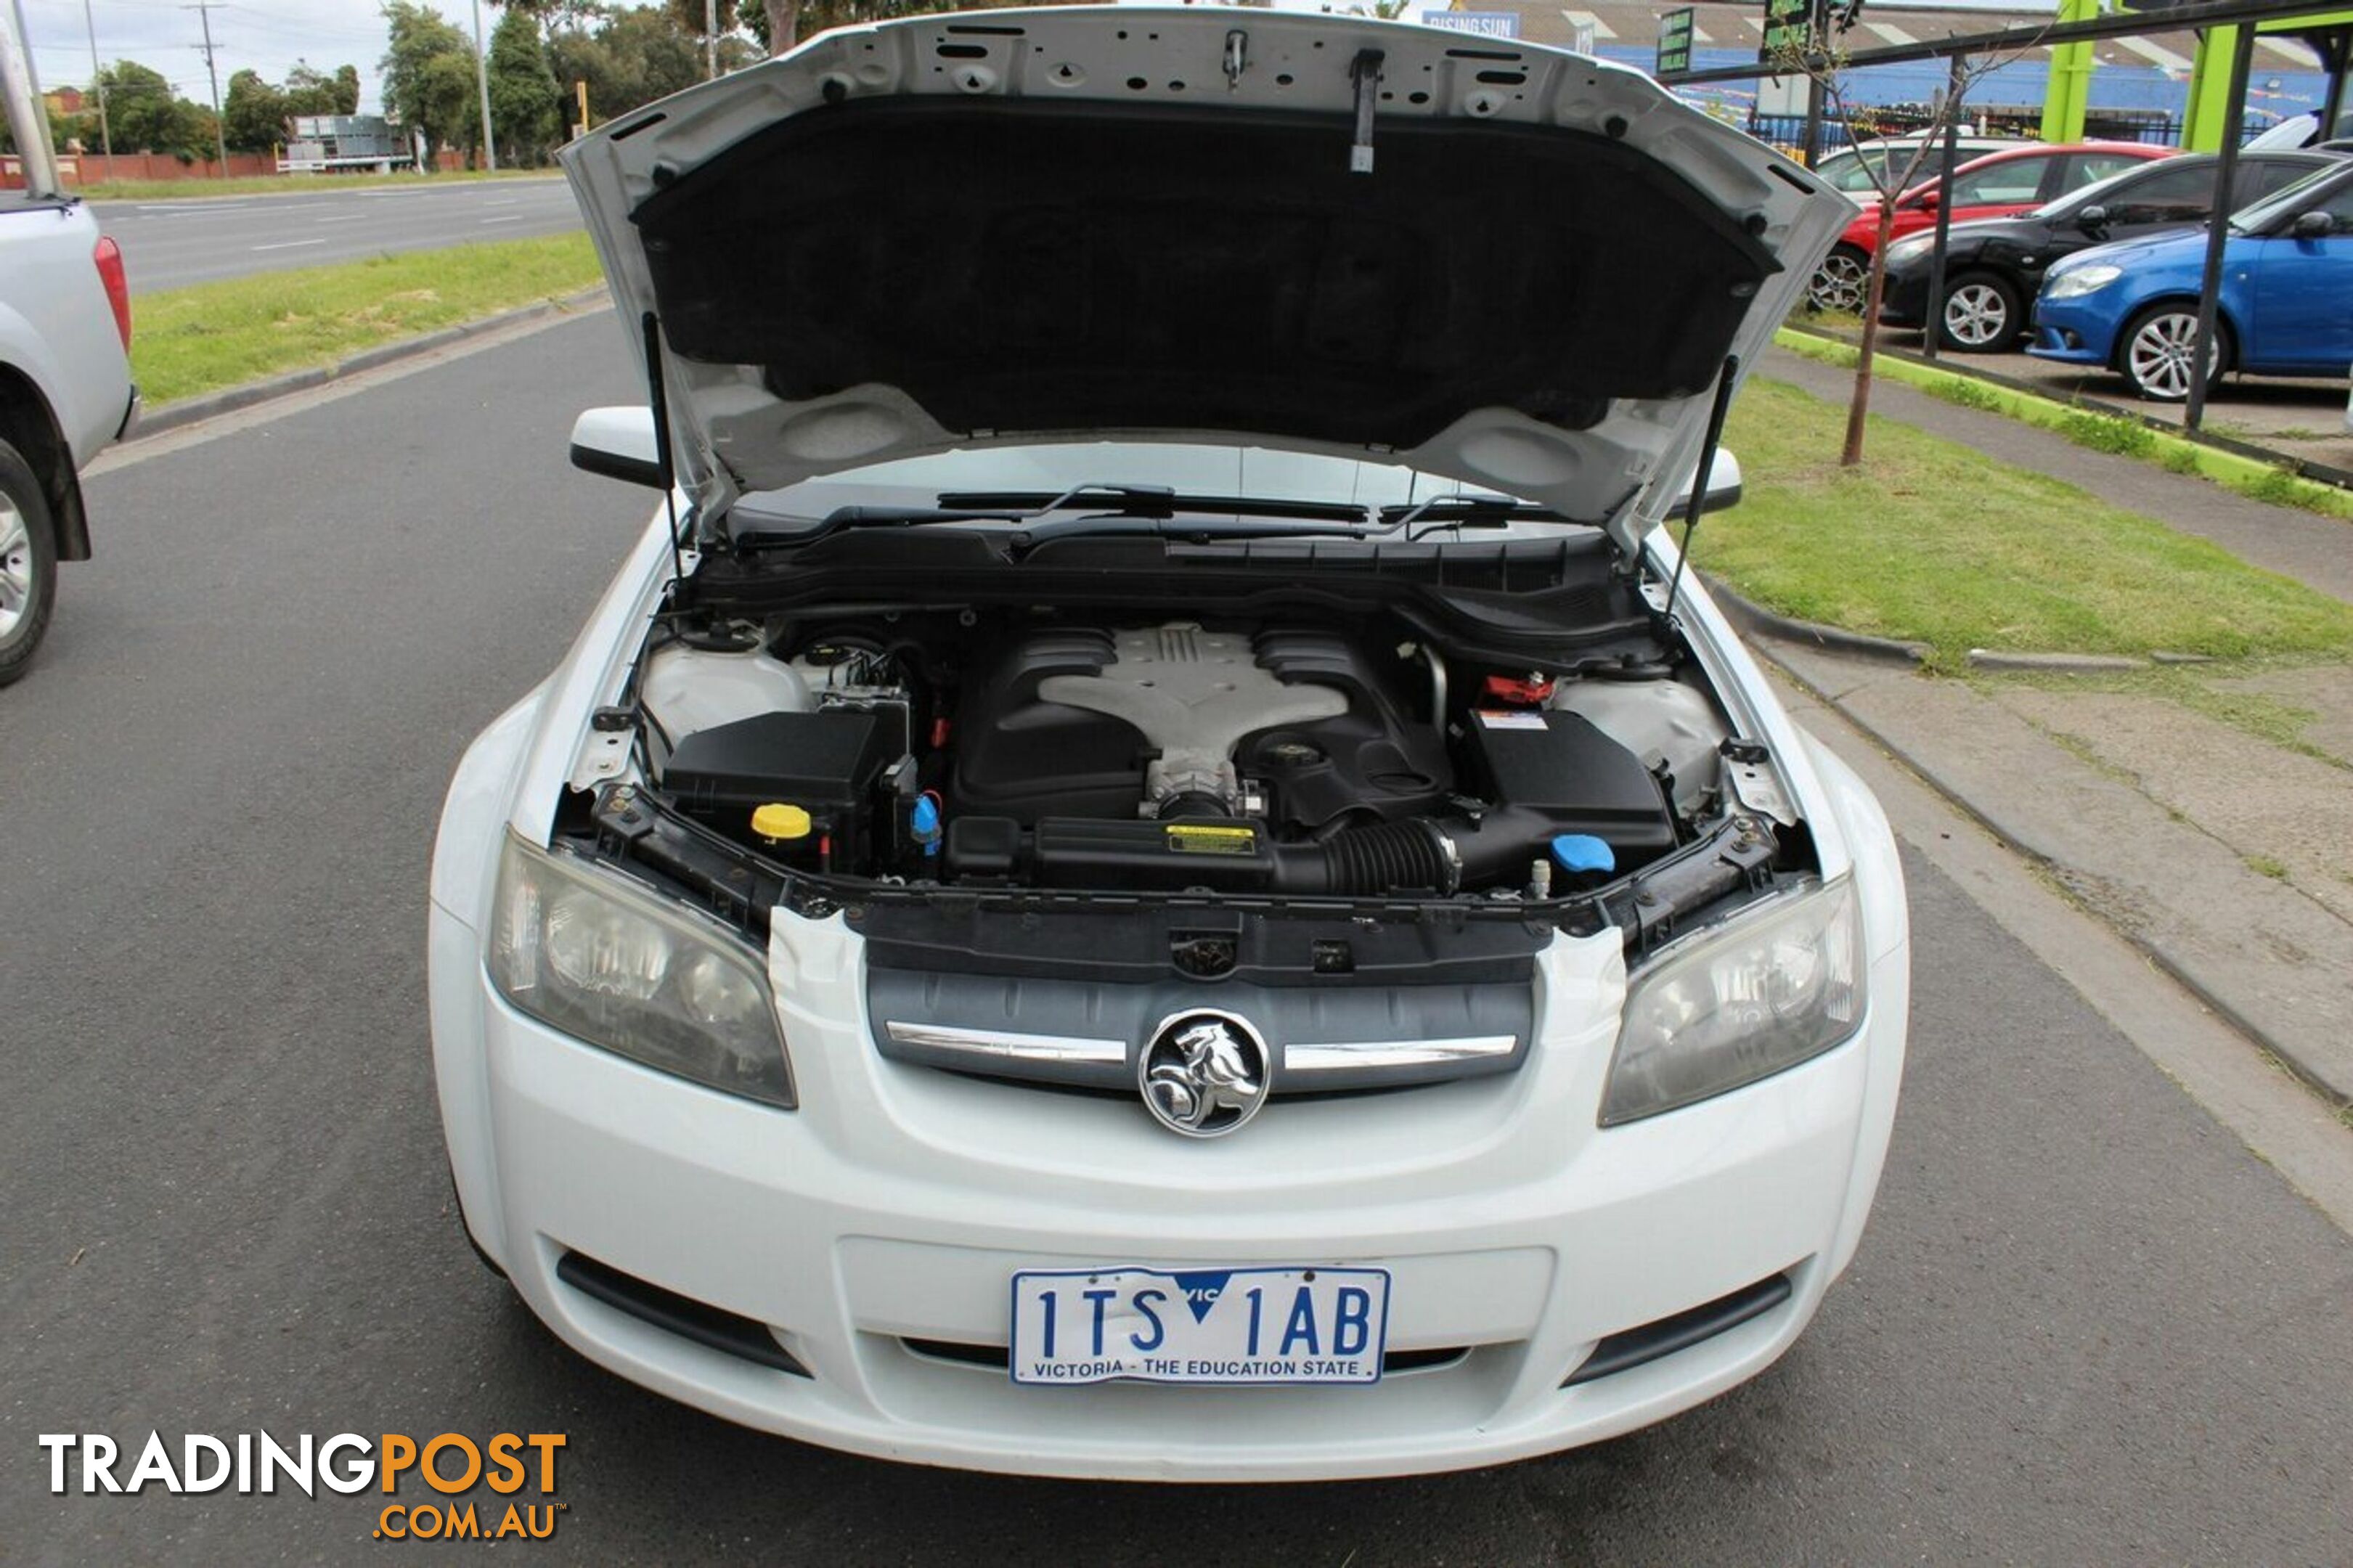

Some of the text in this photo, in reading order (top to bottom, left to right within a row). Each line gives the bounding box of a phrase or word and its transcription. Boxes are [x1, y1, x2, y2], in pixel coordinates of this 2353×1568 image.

[1182, 1289, 1219, 1302] VIC
[1037, 1286, 1371, 1358] 1TS 1AB
[1035, 1360, 1123, 1378] VICTORIA
[1145, 1359, 1180, 1375] THE
[1188, 1360, 1296, 1376] EDUCATION
[1302, 1360, 1358, 1376] STATE
